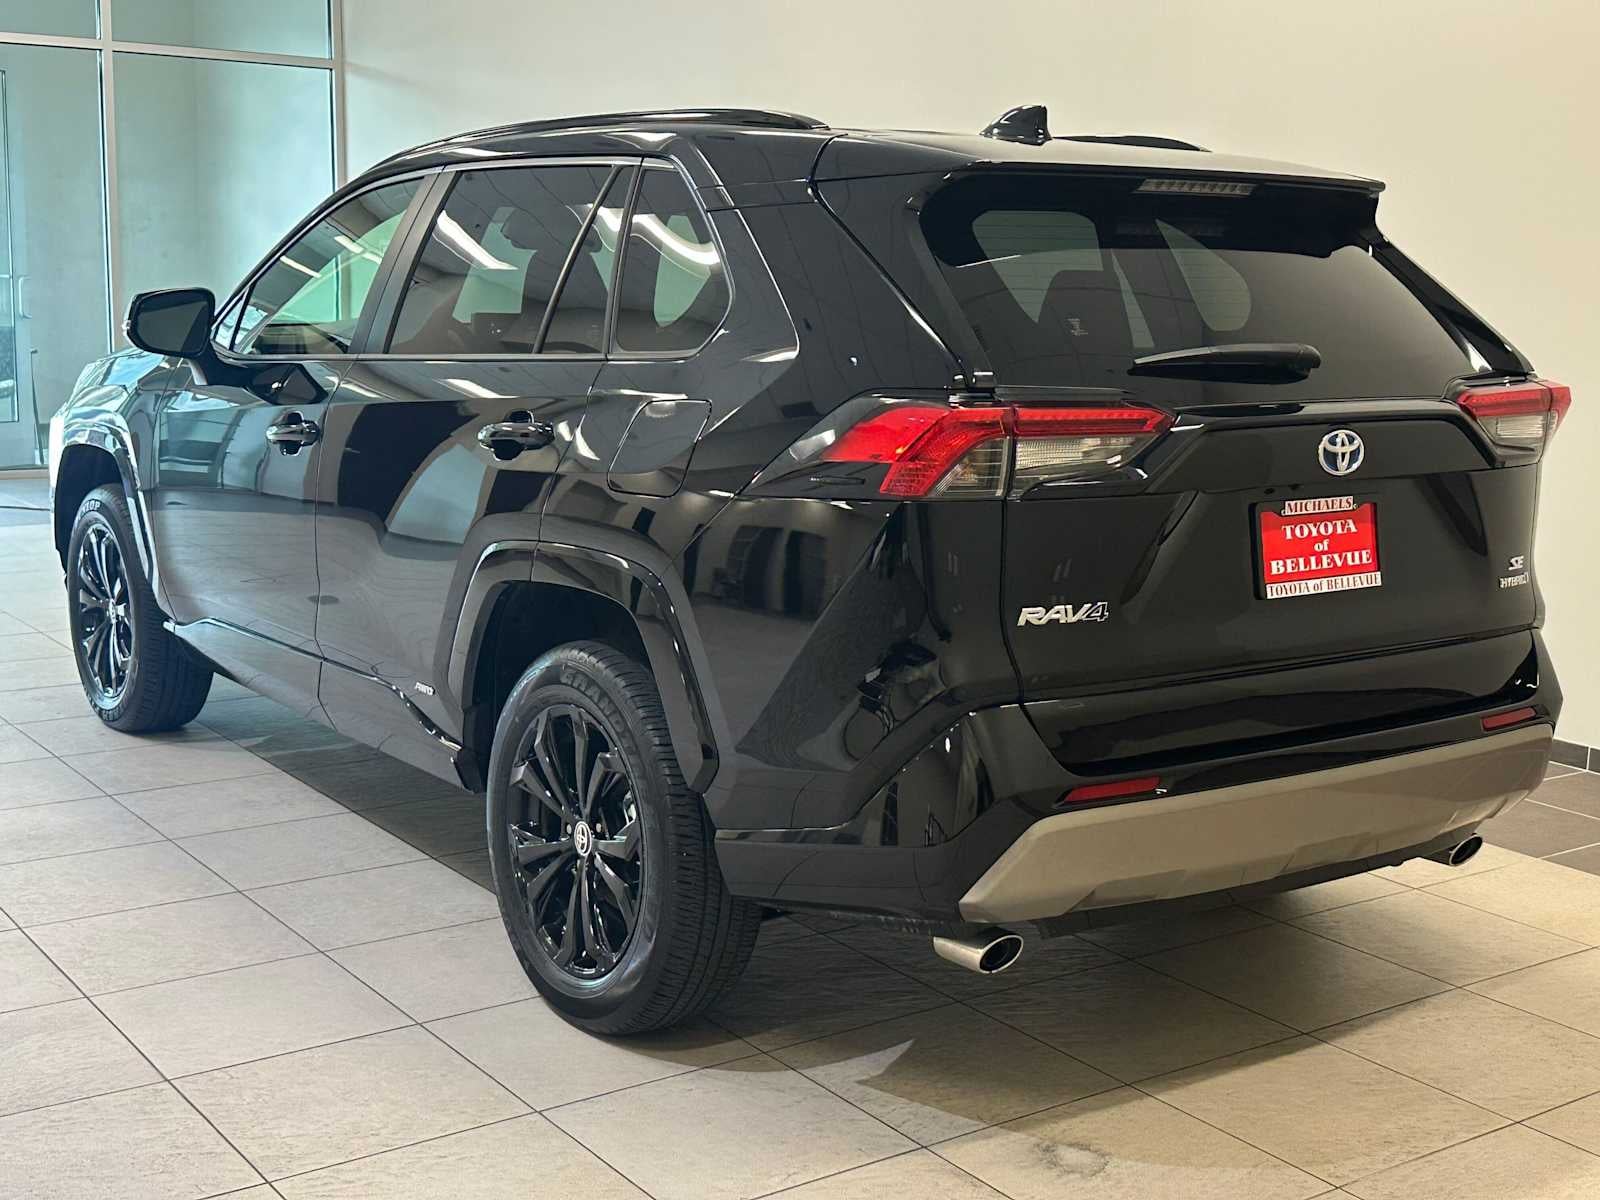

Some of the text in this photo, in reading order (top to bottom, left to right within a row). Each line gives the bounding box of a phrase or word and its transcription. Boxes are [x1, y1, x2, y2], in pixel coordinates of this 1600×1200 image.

[1286, 498, 1352, 513] MICHAELS
[1282, 519, 1357, 539] TOYOTA
[1313, 539, 1329, 552] of
[1270, 550, 1372, 575] BELLEVUE
[1268, 573, 1380, 597] TOYOTA of BELLEVUE
[1016, 601, 1110, 627] RAV4
